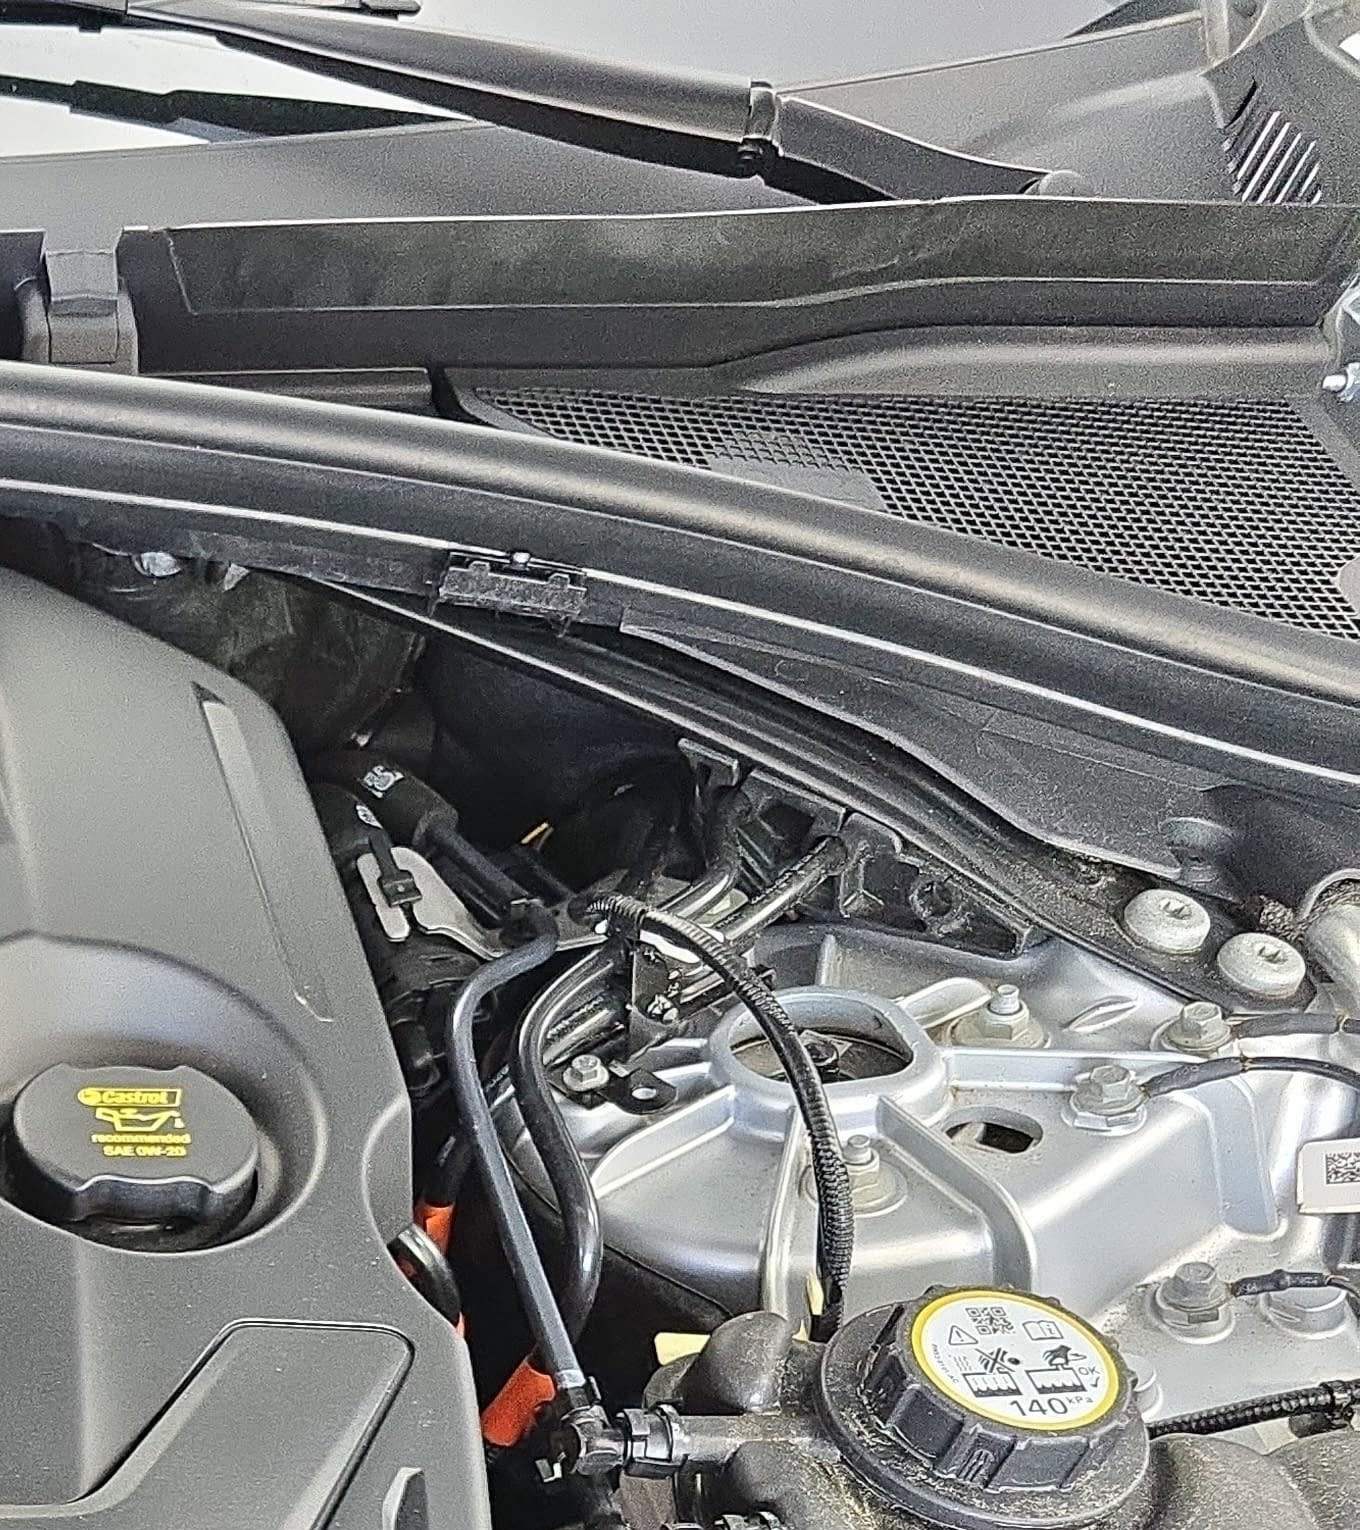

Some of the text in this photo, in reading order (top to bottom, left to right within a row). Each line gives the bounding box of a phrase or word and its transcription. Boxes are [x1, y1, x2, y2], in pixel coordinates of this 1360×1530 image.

[102, 1090, 168, 1104] Castrol
[92, 1133, 191, 1144] recommended
[103, 1146, 135, 1157] SAE
[1078, 1366, 1101, 1376] OK
[1010, 1396, 1094, 1417] 140 kPa
